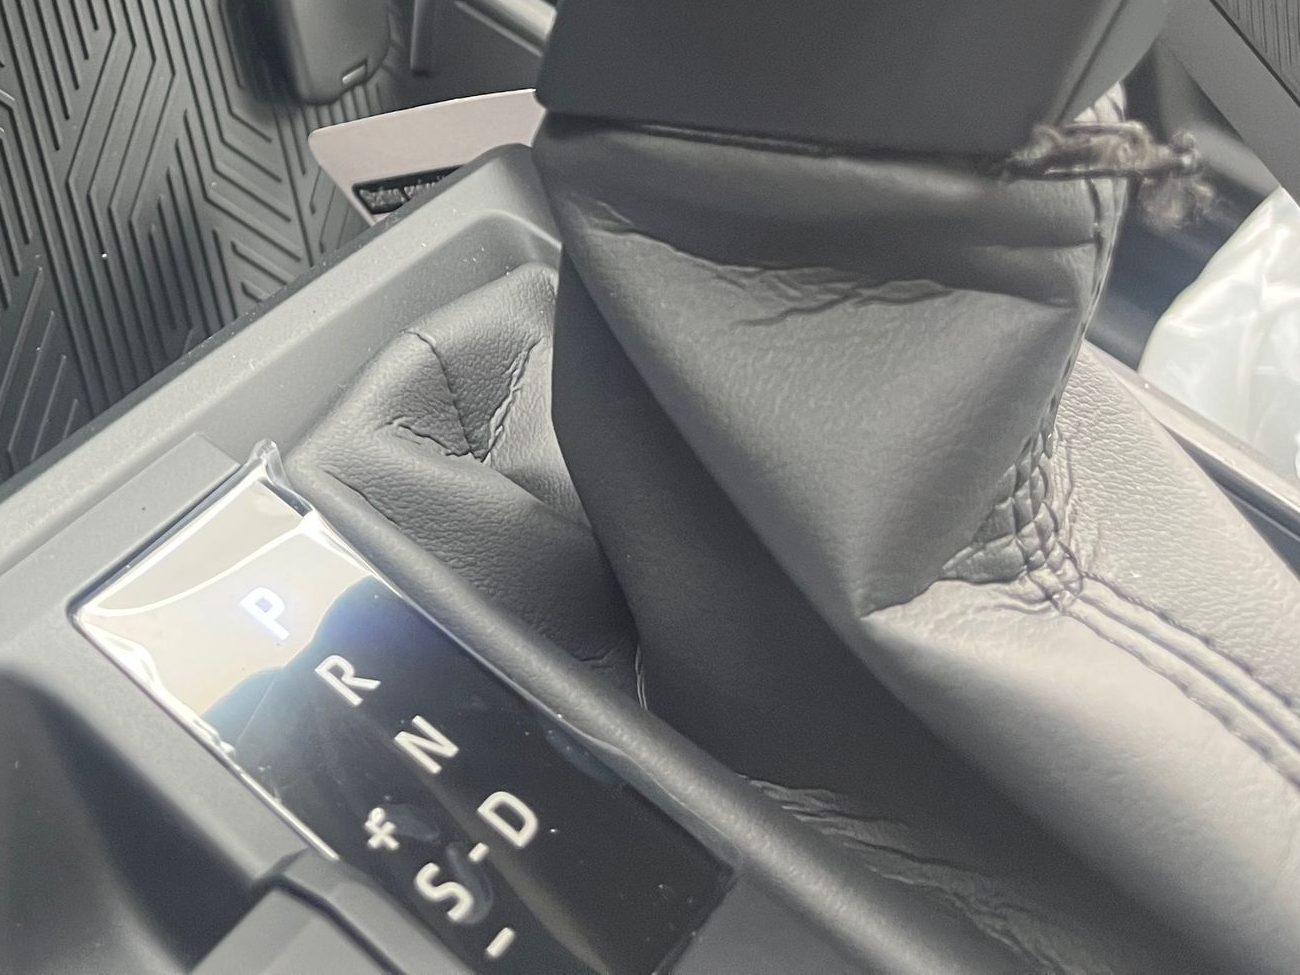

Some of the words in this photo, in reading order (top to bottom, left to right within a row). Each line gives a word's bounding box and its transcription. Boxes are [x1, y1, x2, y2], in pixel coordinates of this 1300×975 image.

[240, 587, 290, 641] P
[314, 655, 381, 706] R
[395, 715, 459, 773] N
[478, 791, 538, 847] D
[415, 863, 474, 920] S
